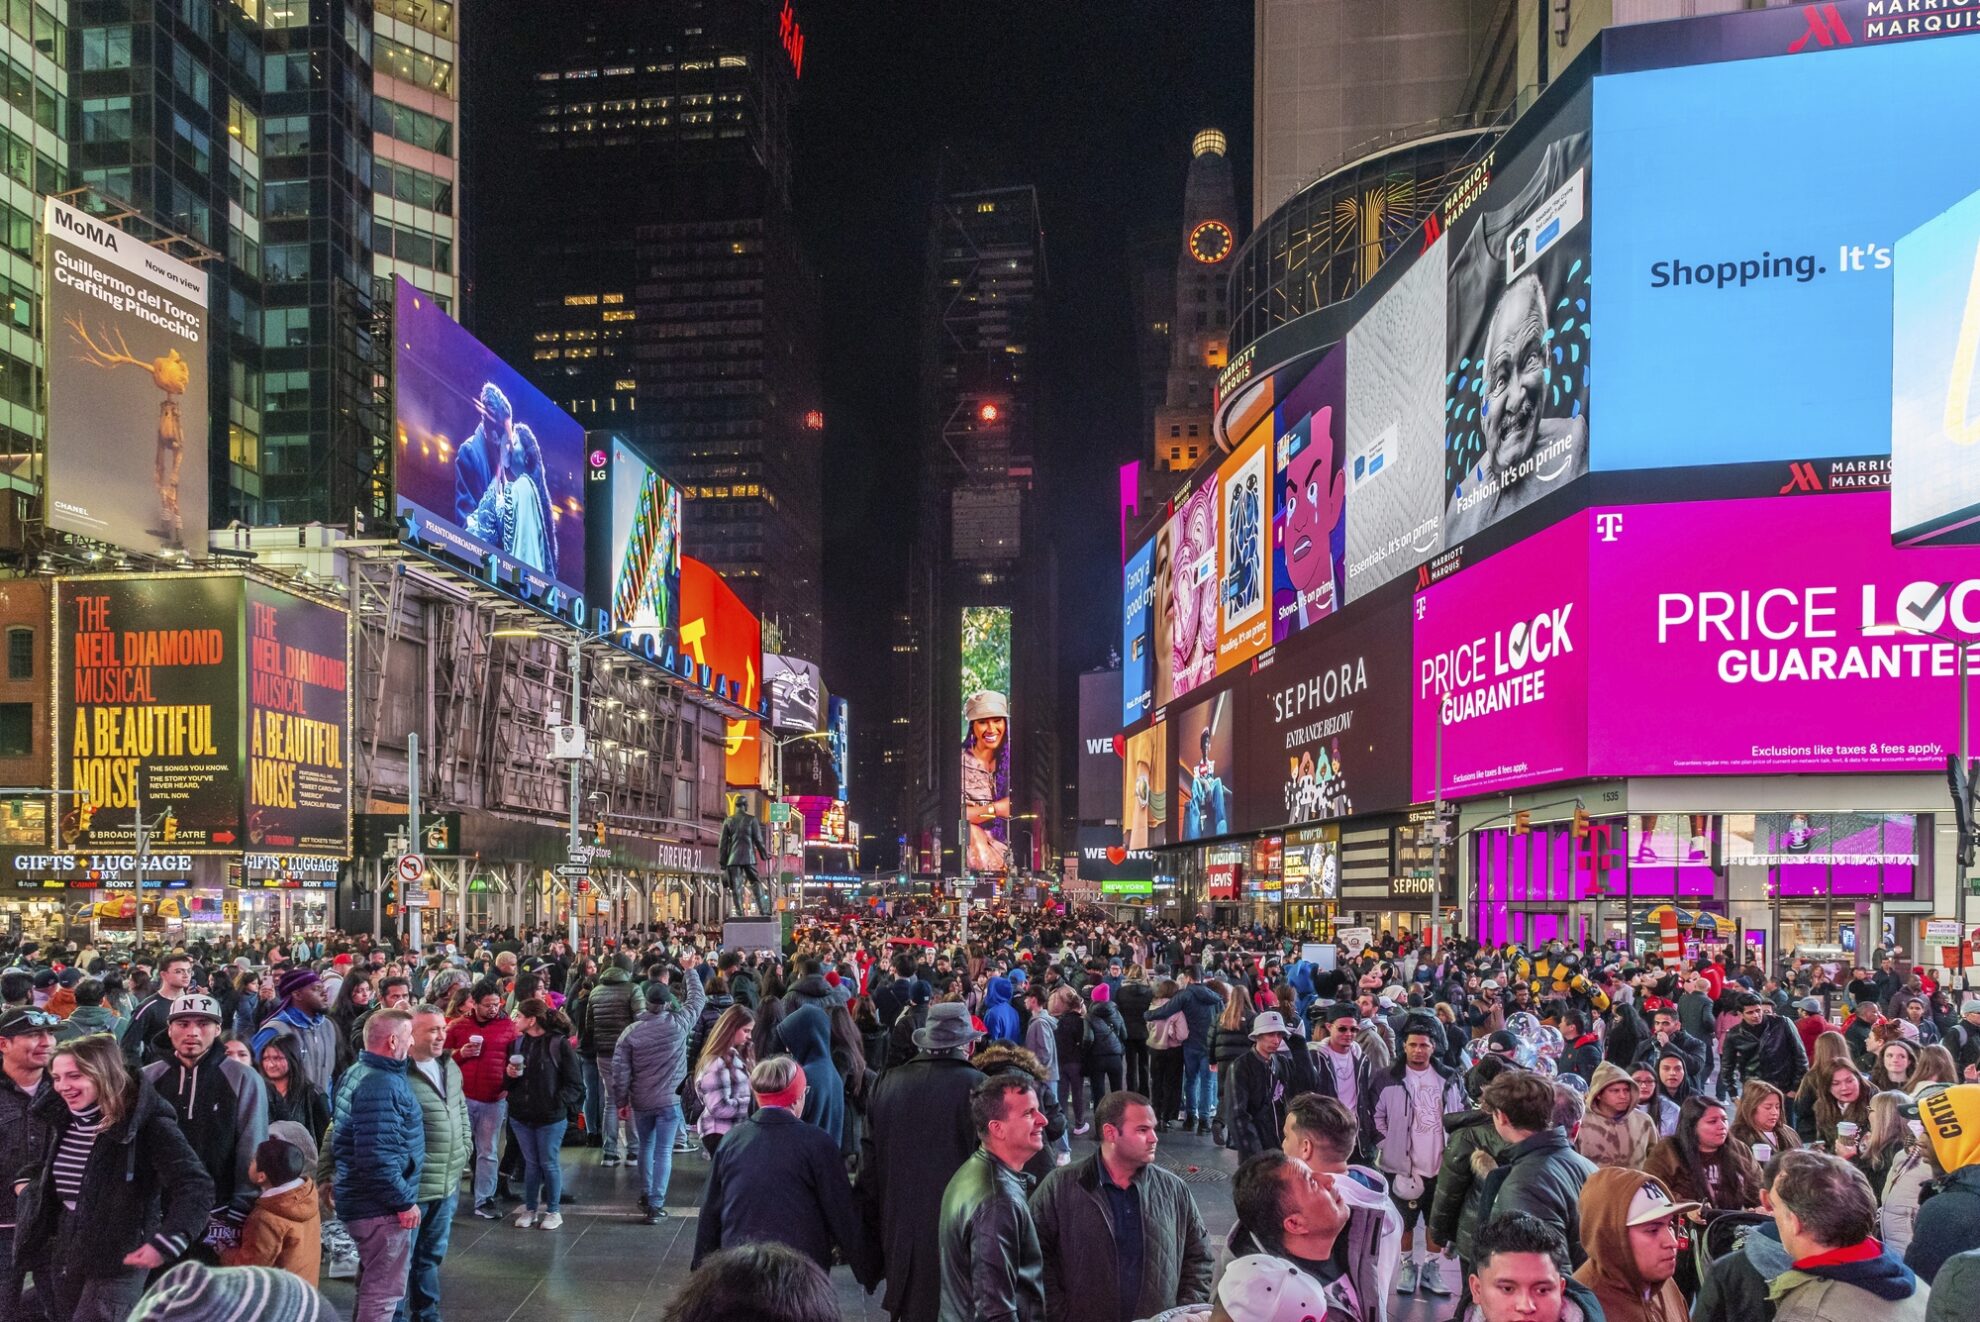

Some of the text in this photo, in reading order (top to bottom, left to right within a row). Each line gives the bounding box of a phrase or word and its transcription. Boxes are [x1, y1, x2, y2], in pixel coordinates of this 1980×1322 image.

[1444, 151, 1496, 212] MARRIOTT
[1444, 179, 1489, 230] MARQUIS
[54, 207, 119, 253] MoMA
[145, 259, 201, 294] Now on view
[1650, 243, 1892, 289] Shopping. It's
[54, 250, 200, 329] Guillermo del Toro:
[54, 266, 199, 343] Crafting Pinocchio
[1220, 345, 1256, 387] MARRIOTT
[1220, 365, 1250, 401] MARQUIS
[591, 470, 606, 481] LG
[1456, 433, 1573, 514] Fashion. It's on prime
[54, 501, 89, 516] CHANEL
[1349, 515, 1439, 579] Essentials. It's on prime
[1431, 545, 1464, 570] MARRIOTT
[1126, 571, 1144, 593] Fancy
[1431, 559, 1460, 581] MARQUIS
[75, 596, 110, 632] THE
[1126, 592, 1143, 625] good
[1278, 598, 1298, 621] Shows.
[1307, 588, 1316, 604] on
[1315, 578, 1335, 604] prime
[1657, 586, 1838, 644] PRICE
[253, 602, 277, 640] THE
[488, 554, 741, 696] 1540 BROADWAY
[75, 629, 223, 668] NEIL DIAMOND
[253, 637, 345, 692] NEIL DIAMOND
[1421, 602, 1574, 700] PRICE LOCK
[1717, 643, 1980, 684] GUARANTEE
[75, 667, 157, 703] MUSICAL
[252, 673, 306, 715] MUSICAL
[1274, 657, 1368, 723] SEPHORA
[1440, 669, 1546, 727] GUARANTEE
[74, 704, 217, 758] A BEAUTIFUL
[252, 707, 343, 769] A BEAUTIFUL
[1086, 737, 1114, 755] WE
[1285, 710, 1354, 750] ENTRANCE BELOW
[1751, 742, 1944, 757] Exclusions like taxes & fees apply.
[73, 757, 141, 809] NOISE
[251, 754, 297, 810] NOISE
[1453, 773, 1476, 784] Exclusions
[1475, 771, 1484, 780] like
[1484, 768, 1497, 778] taxes
[1501, 765, 1513, 775] fees
[1512, 761, 1529, 774] apply.
[1602, 791, 1619, 802] 1535
[15, 855, 192, 871] GIFTS LUGGAGE
[244, 856, 339, 873] GIFTS LUGGAGE
[658, 844, 702, 870] FOREVER 21
[1084, 847, 1153, 859] WE NYC
[70, 880, 98, 888] Canon
[100, 870, 119, 880] NY
[302, 880, 322, 888] SONY
[182, 998, 212, 1011] NY
